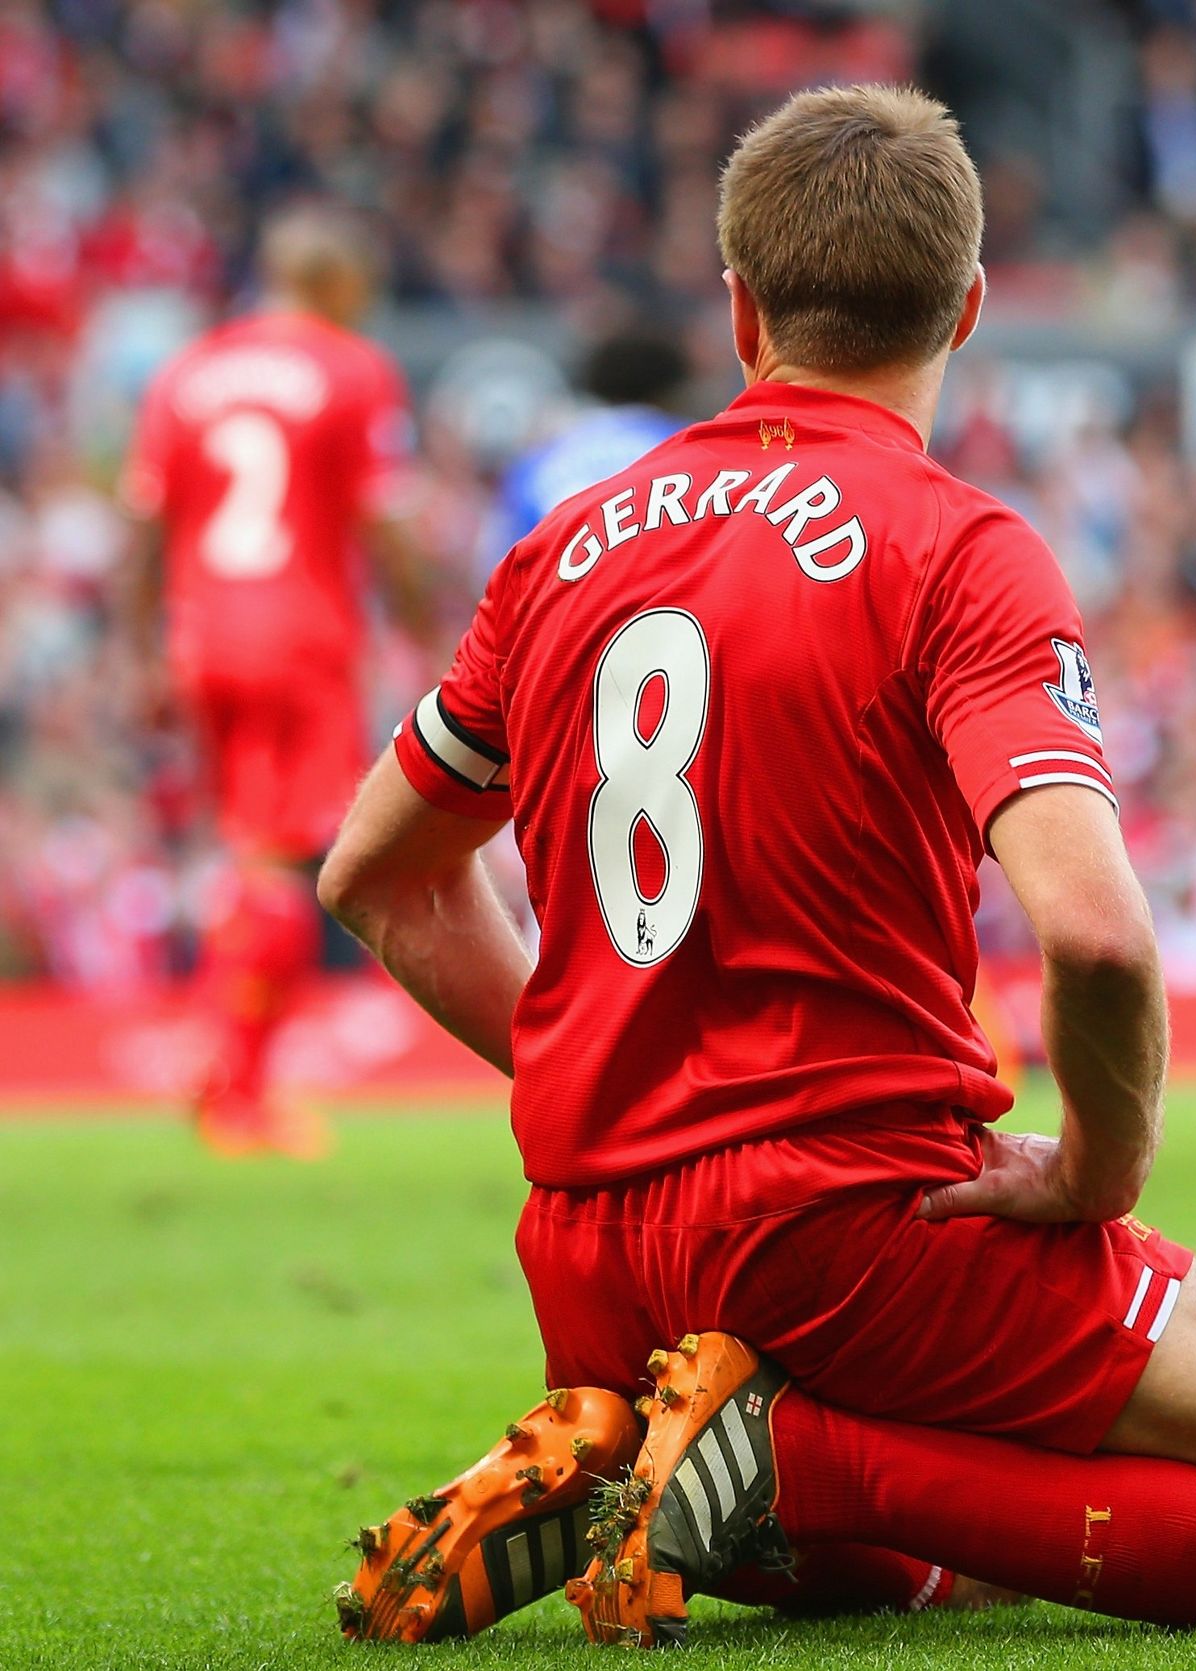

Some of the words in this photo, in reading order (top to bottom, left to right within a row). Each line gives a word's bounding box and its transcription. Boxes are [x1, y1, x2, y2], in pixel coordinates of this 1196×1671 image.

[204, 409, 295, 578] 2
[557, 461, 867, 583] GERRARD
[587, 606, 711, 969] 8
